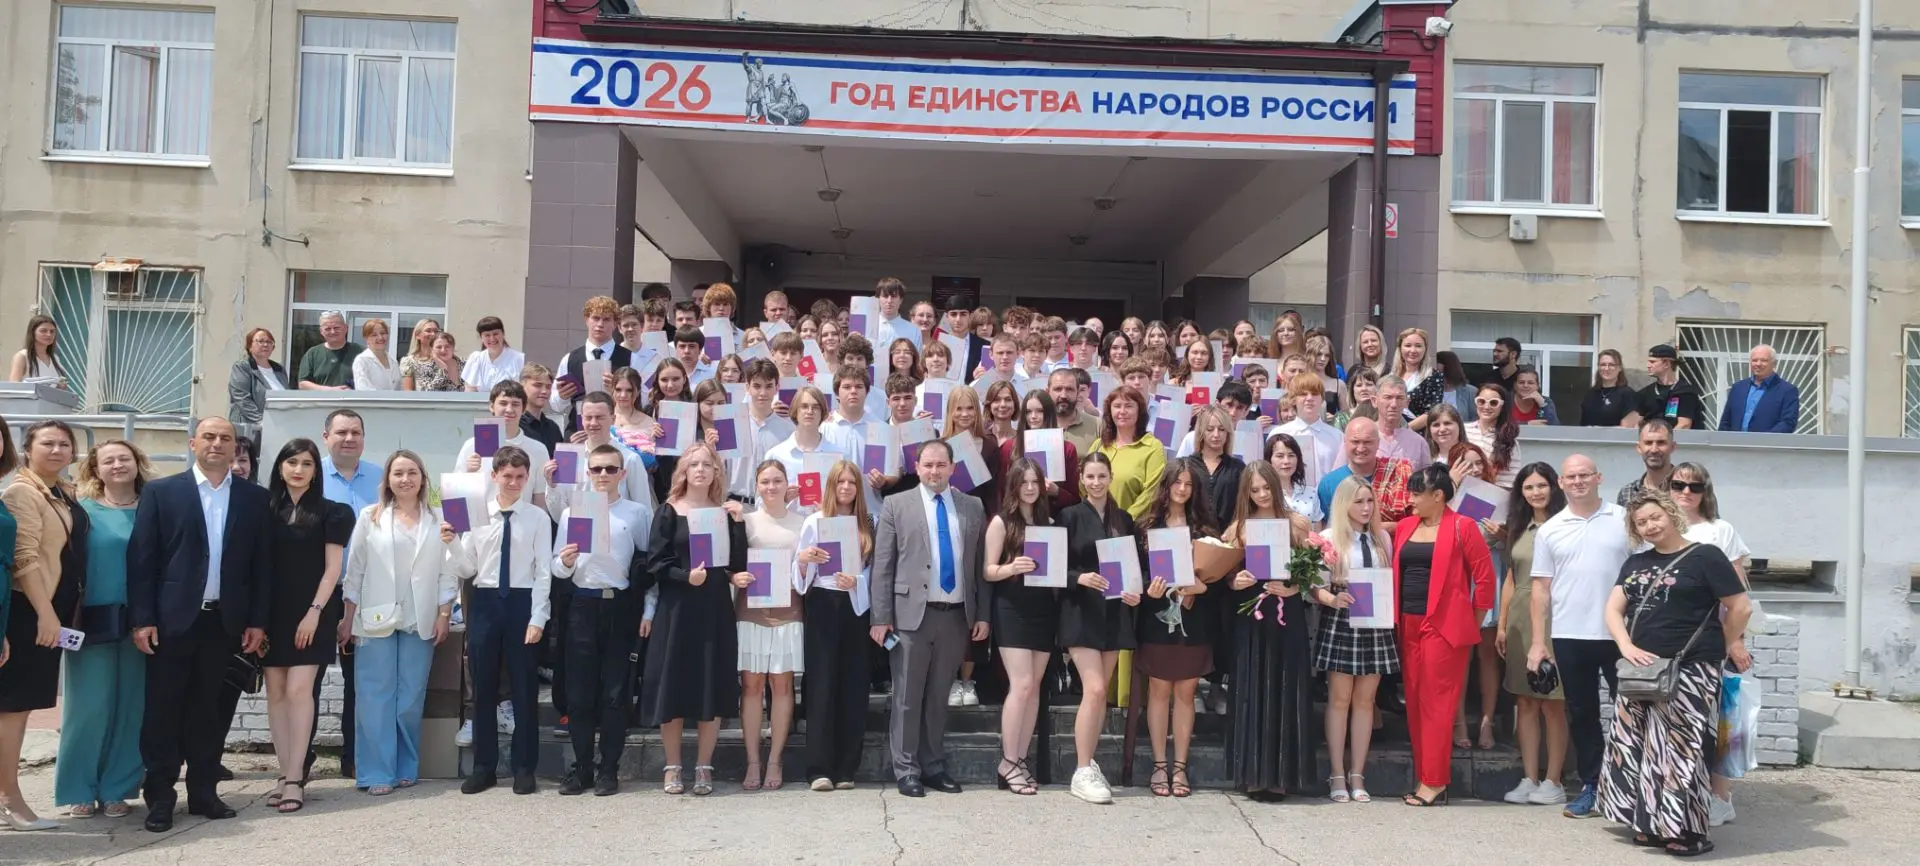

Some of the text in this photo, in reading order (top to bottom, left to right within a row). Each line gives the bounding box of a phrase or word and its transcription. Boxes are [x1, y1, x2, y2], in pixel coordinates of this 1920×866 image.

[571, 58, 712, 111] 2026
[830, 81, 896, 111] ГОД
[908, 85, 1082, 113] ЕДИНСТВА
[1092, 91, 1250, 120] НАРОДОВ
